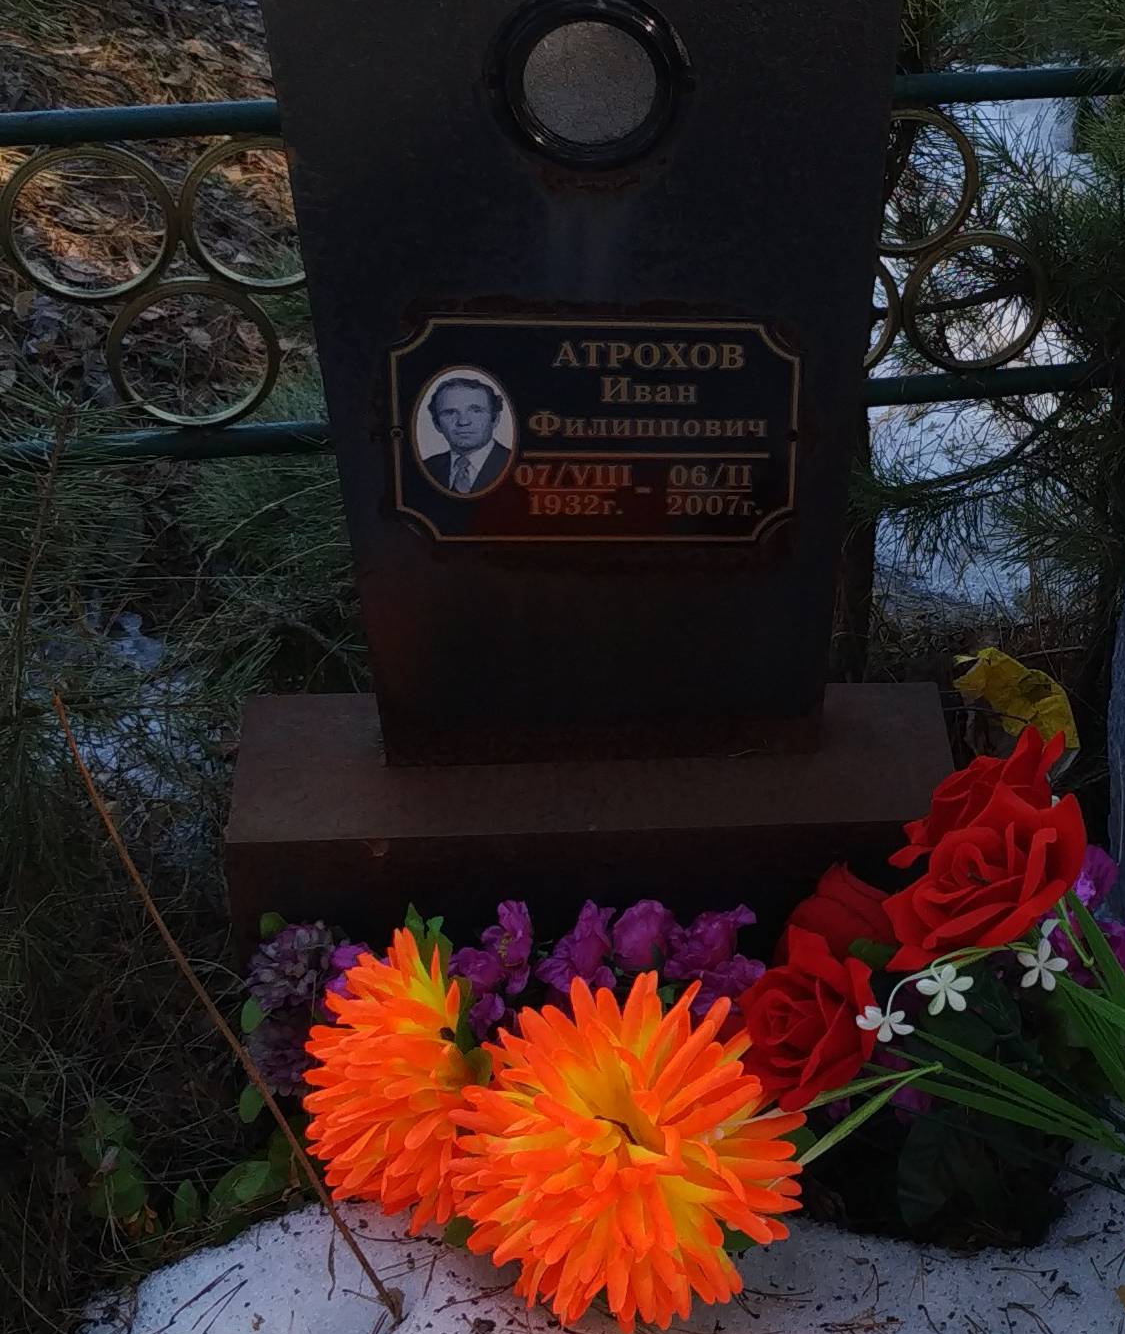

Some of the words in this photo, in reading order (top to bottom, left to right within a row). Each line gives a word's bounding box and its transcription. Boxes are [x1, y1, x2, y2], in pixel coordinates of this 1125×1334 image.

[551, 341, 746, 370] АТРОХОВ
[600, 375, 697, 404] Иван
[528, 410, 768, 438] Филиппович
[513, 462, 633, 488] 07/VIII
[668, 462, 753, 488] 06/II
[528, 494, 624, 516] 1932г.
[665, 494, 763, 516] 2007г.
